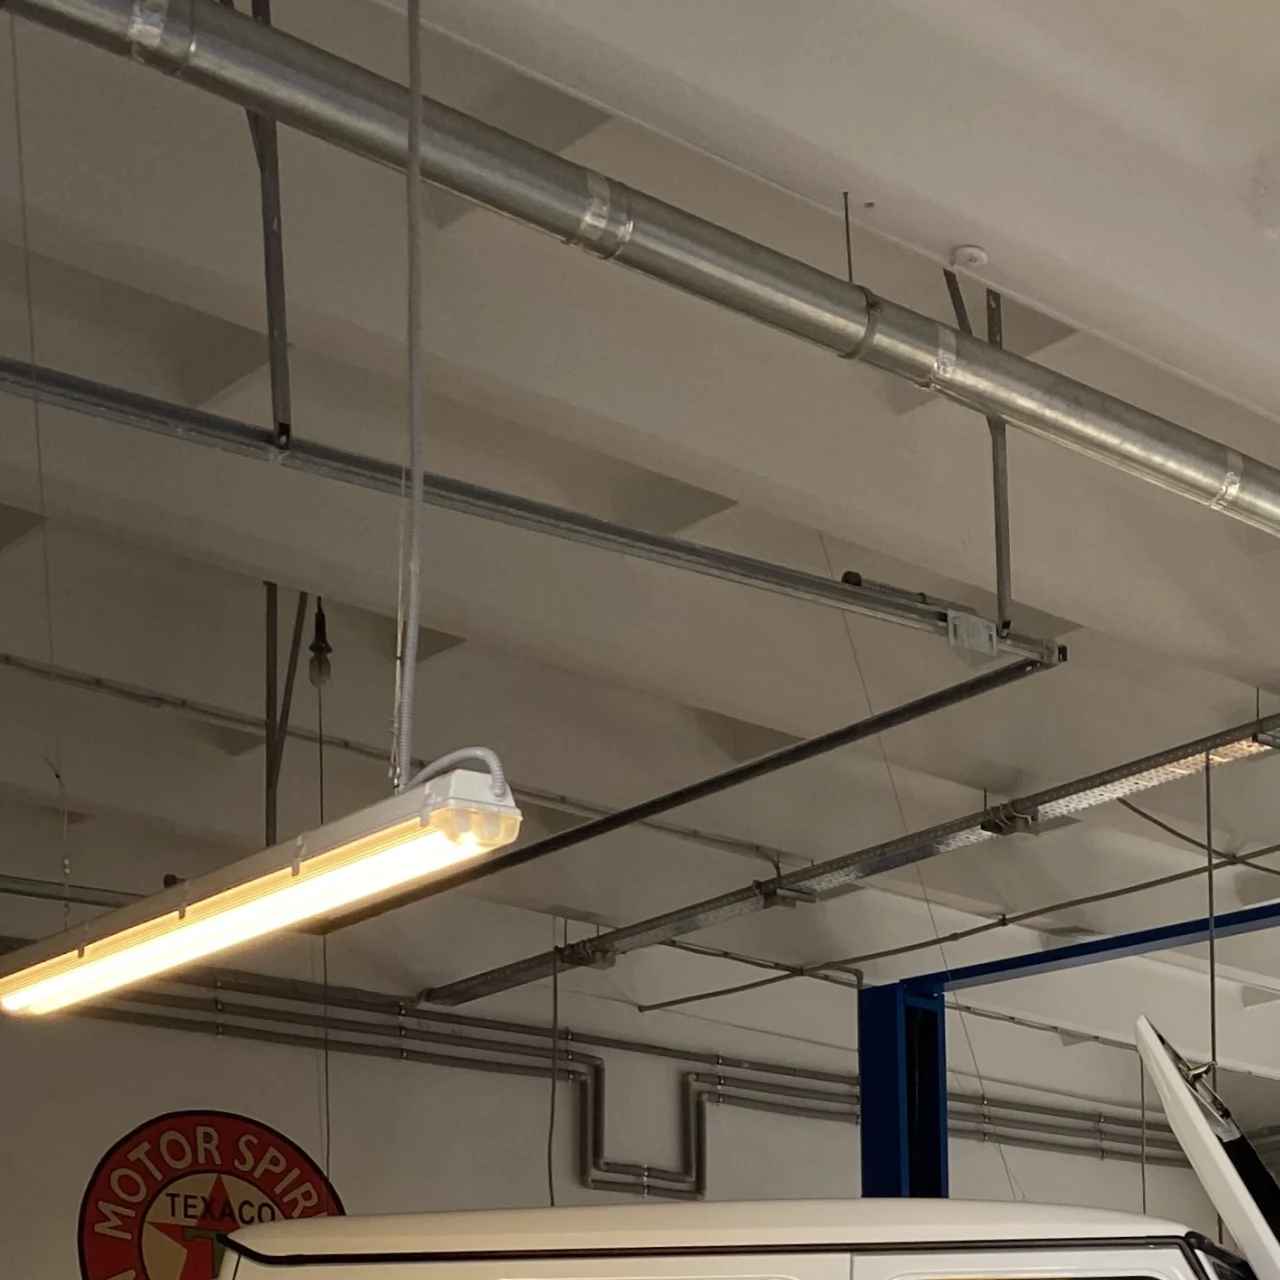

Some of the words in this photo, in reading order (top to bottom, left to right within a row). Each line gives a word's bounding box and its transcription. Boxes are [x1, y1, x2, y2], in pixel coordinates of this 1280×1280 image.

[93, 1125, 223, 1241] MOTOR
[233, 1133, 328, 1218] SPIR
[164, 1192, 276, 1225] TEXACO
